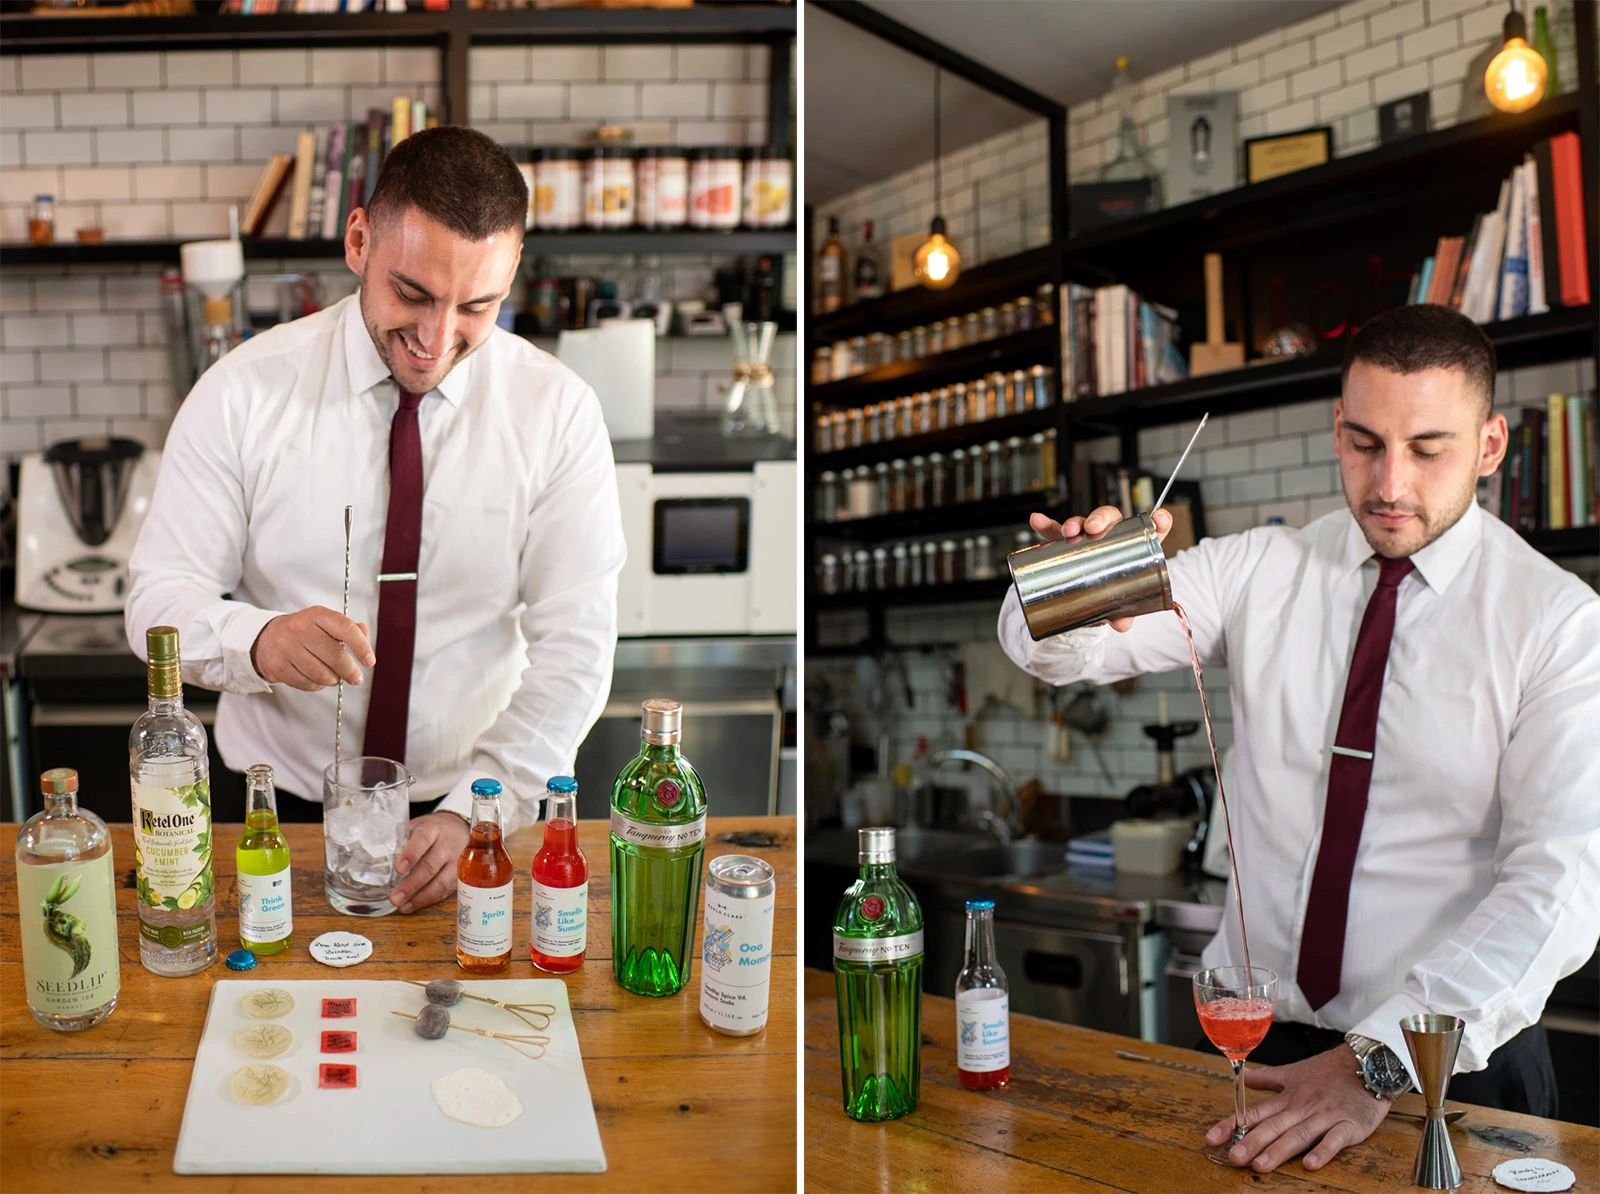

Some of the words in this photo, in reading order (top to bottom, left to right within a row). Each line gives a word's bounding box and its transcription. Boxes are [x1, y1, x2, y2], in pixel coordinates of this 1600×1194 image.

[141, 810, 171, 833] Ketel
[172, 813, 195, 828] One
[155, 828, 195, 837] BOTANICAL
[626, 826, 676, 843] Tanqueray
[690, 829, 702, 838] TEN
[146, 847, 188, 857] CUCUMBER
[159, 857, 179, 866] MINT
[261, 896, 283, 905] Think
[261, 903, 285, 912] Green
[557, 907, 582, 917] Smells
[482, 910, 505, 920] Spritz
[558, 917, 575, 925] Like
[557, 921, 585, 932] Summe
[739, 943, 763, 952] Ooo
[838, 941, 879, 956] Tanqueray
[893, 943, 910, 952] TEN
[36, 973, 107, 994] SEEDLIP
[82, 993, 94, 1001] 108
[720, 992, 736, 1000] Spice
[720, 997, 735, 1006] Soda
